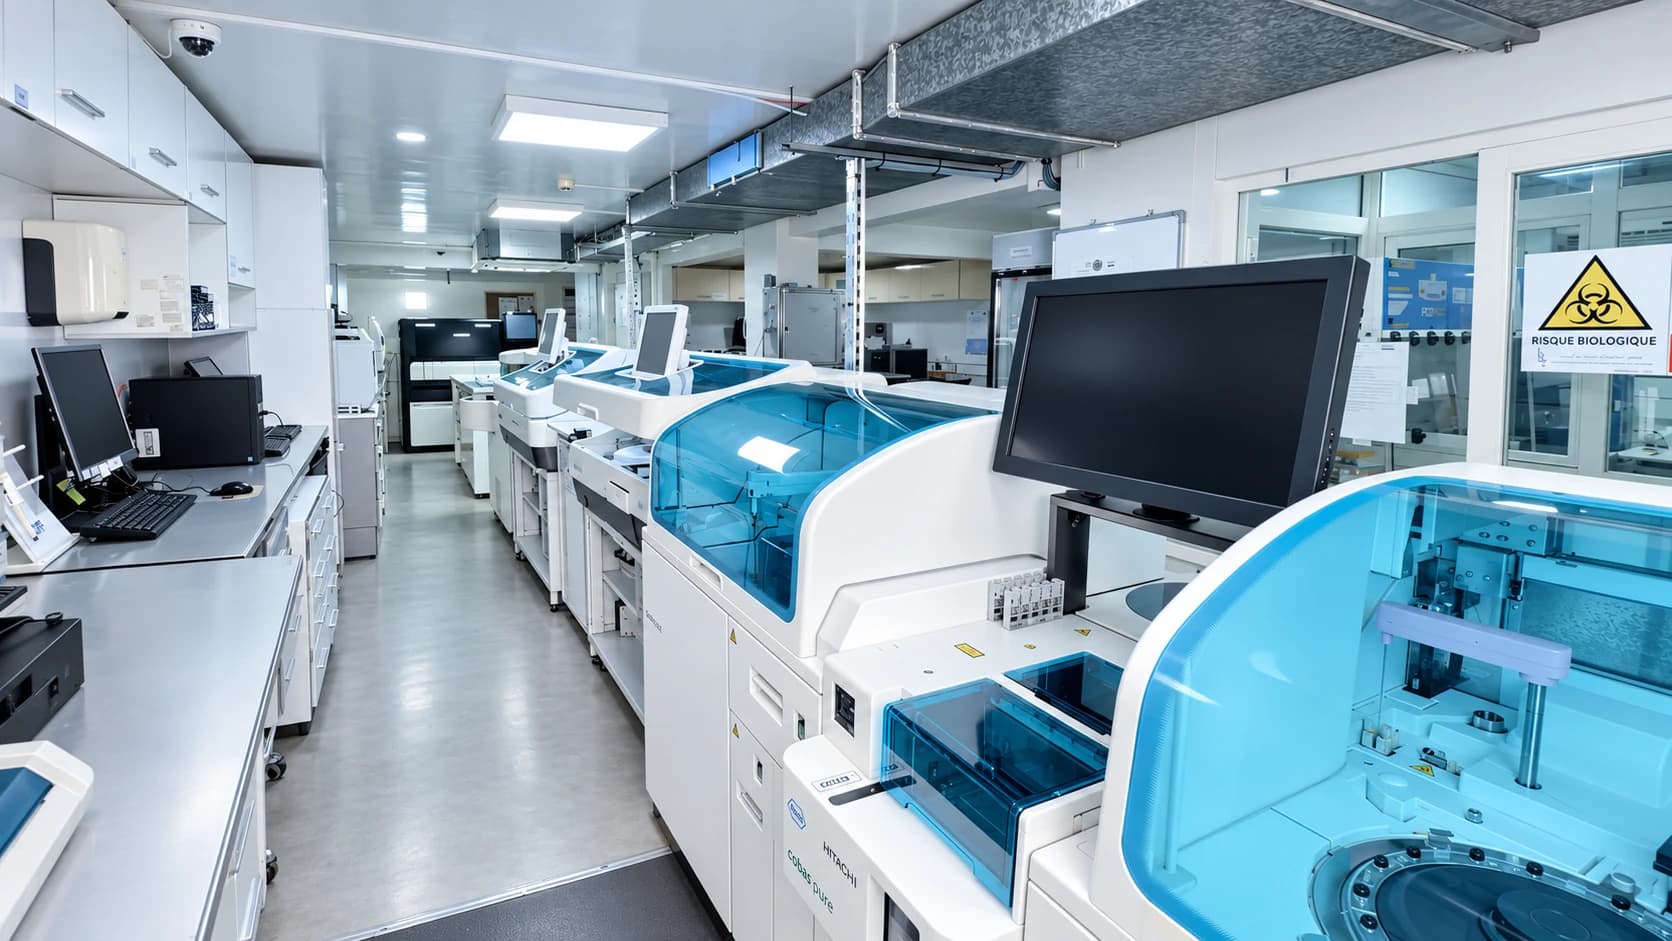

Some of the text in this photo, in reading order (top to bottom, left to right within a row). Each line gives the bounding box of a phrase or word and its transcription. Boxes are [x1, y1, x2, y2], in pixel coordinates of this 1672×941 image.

[1531, 336, 1657, 346] RISQUE BIOLOGIQUE
[787, 849, 812, 885] cobas
[813, 881, 834, 914] pure
[823, 840, 857, 889] HITACHI
